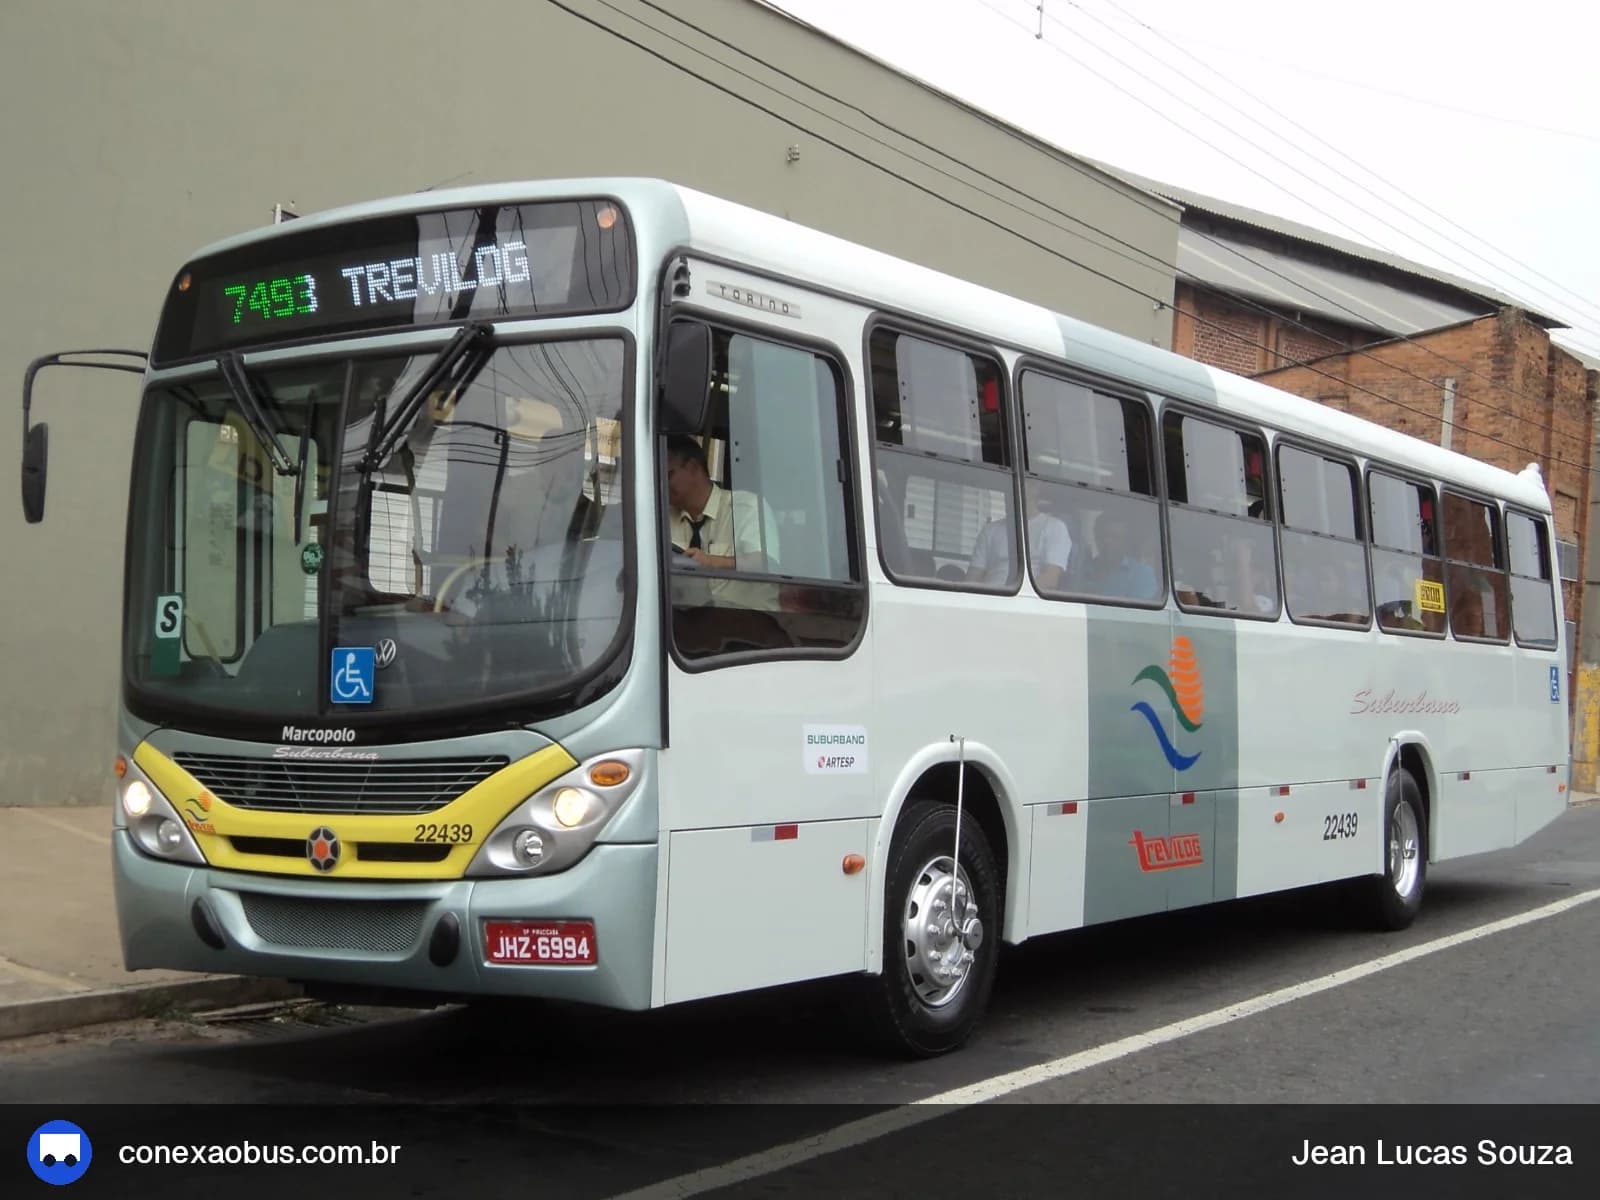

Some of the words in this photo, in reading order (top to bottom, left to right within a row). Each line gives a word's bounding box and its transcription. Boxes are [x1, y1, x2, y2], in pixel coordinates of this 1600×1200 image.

[224, 274, 319, 323] 7493
[342, 241, 530, 306] TREVILOG
[160, 601, 180, 633] S
[1350, 688, 1461, 715] Suburbana
[281, 726, 356, 744] Marcopolo
[807, 734, 865, 745] SUBURBANO
[272, 747, 379, 760] Suburbana
[826, 756, 855, 768] ARTESP
[414, 823, 473, 843] 22439
[1323, 813, 1359, 841] 22439
